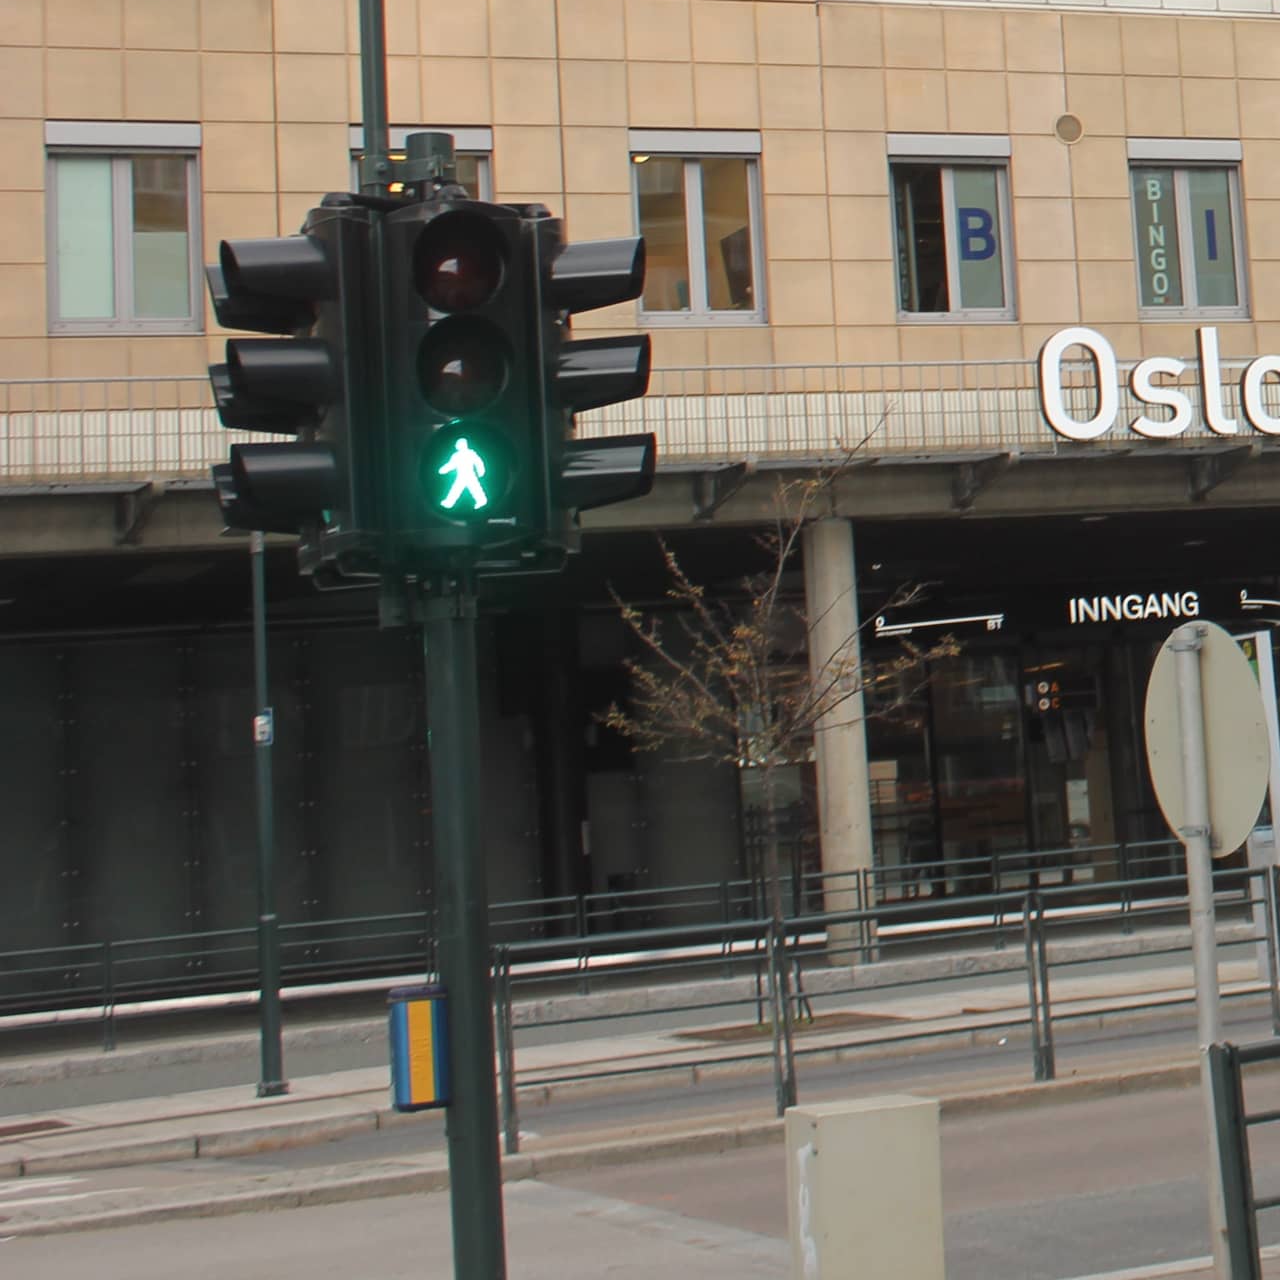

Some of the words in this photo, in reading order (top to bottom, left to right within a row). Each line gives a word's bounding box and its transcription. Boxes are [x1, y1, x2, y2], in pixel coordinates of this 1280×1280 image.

[958, 208, 996, 261] B
[1146, 179, 1170, 297] BINGO
[1070, 591, 1200, 624] INNGANG
